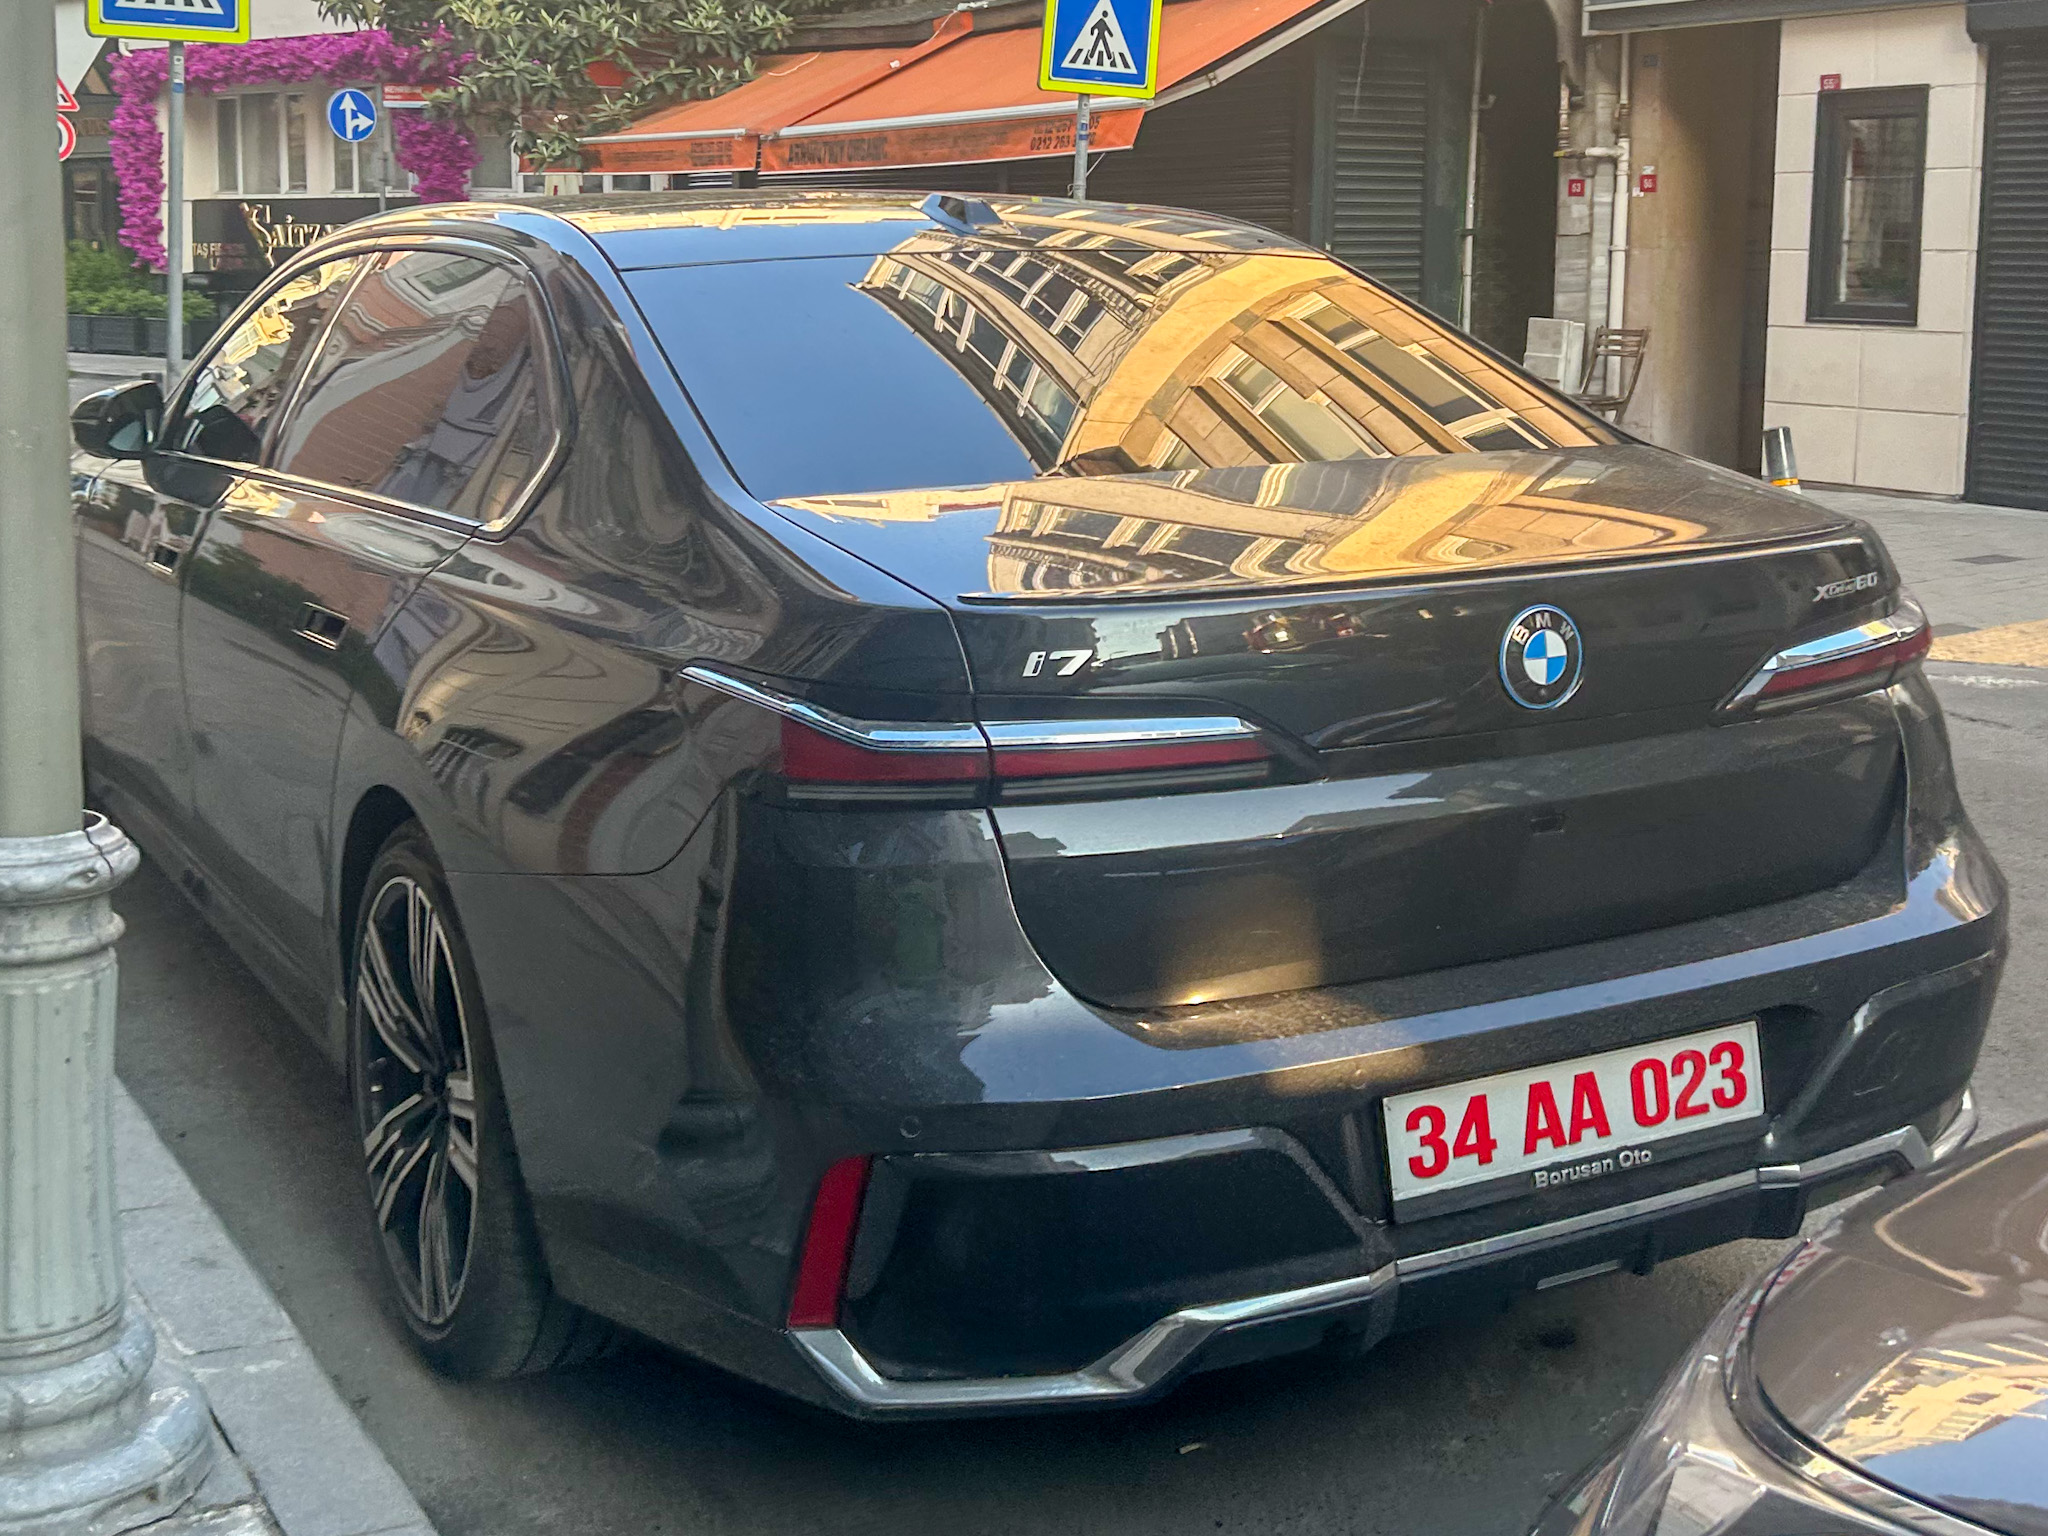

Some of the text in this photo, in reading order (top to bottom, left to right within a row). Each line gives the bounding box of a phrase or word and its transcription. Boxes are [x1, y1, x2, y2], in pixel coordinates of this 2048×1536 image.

[1512, 612, 1575, 646] BMW
[1022, 649, 1094, 677] i7
[1405, 1041, 1748, 1179] 34 AA 023
[1534, 1149, 1653, 1189] Borusan Oto
